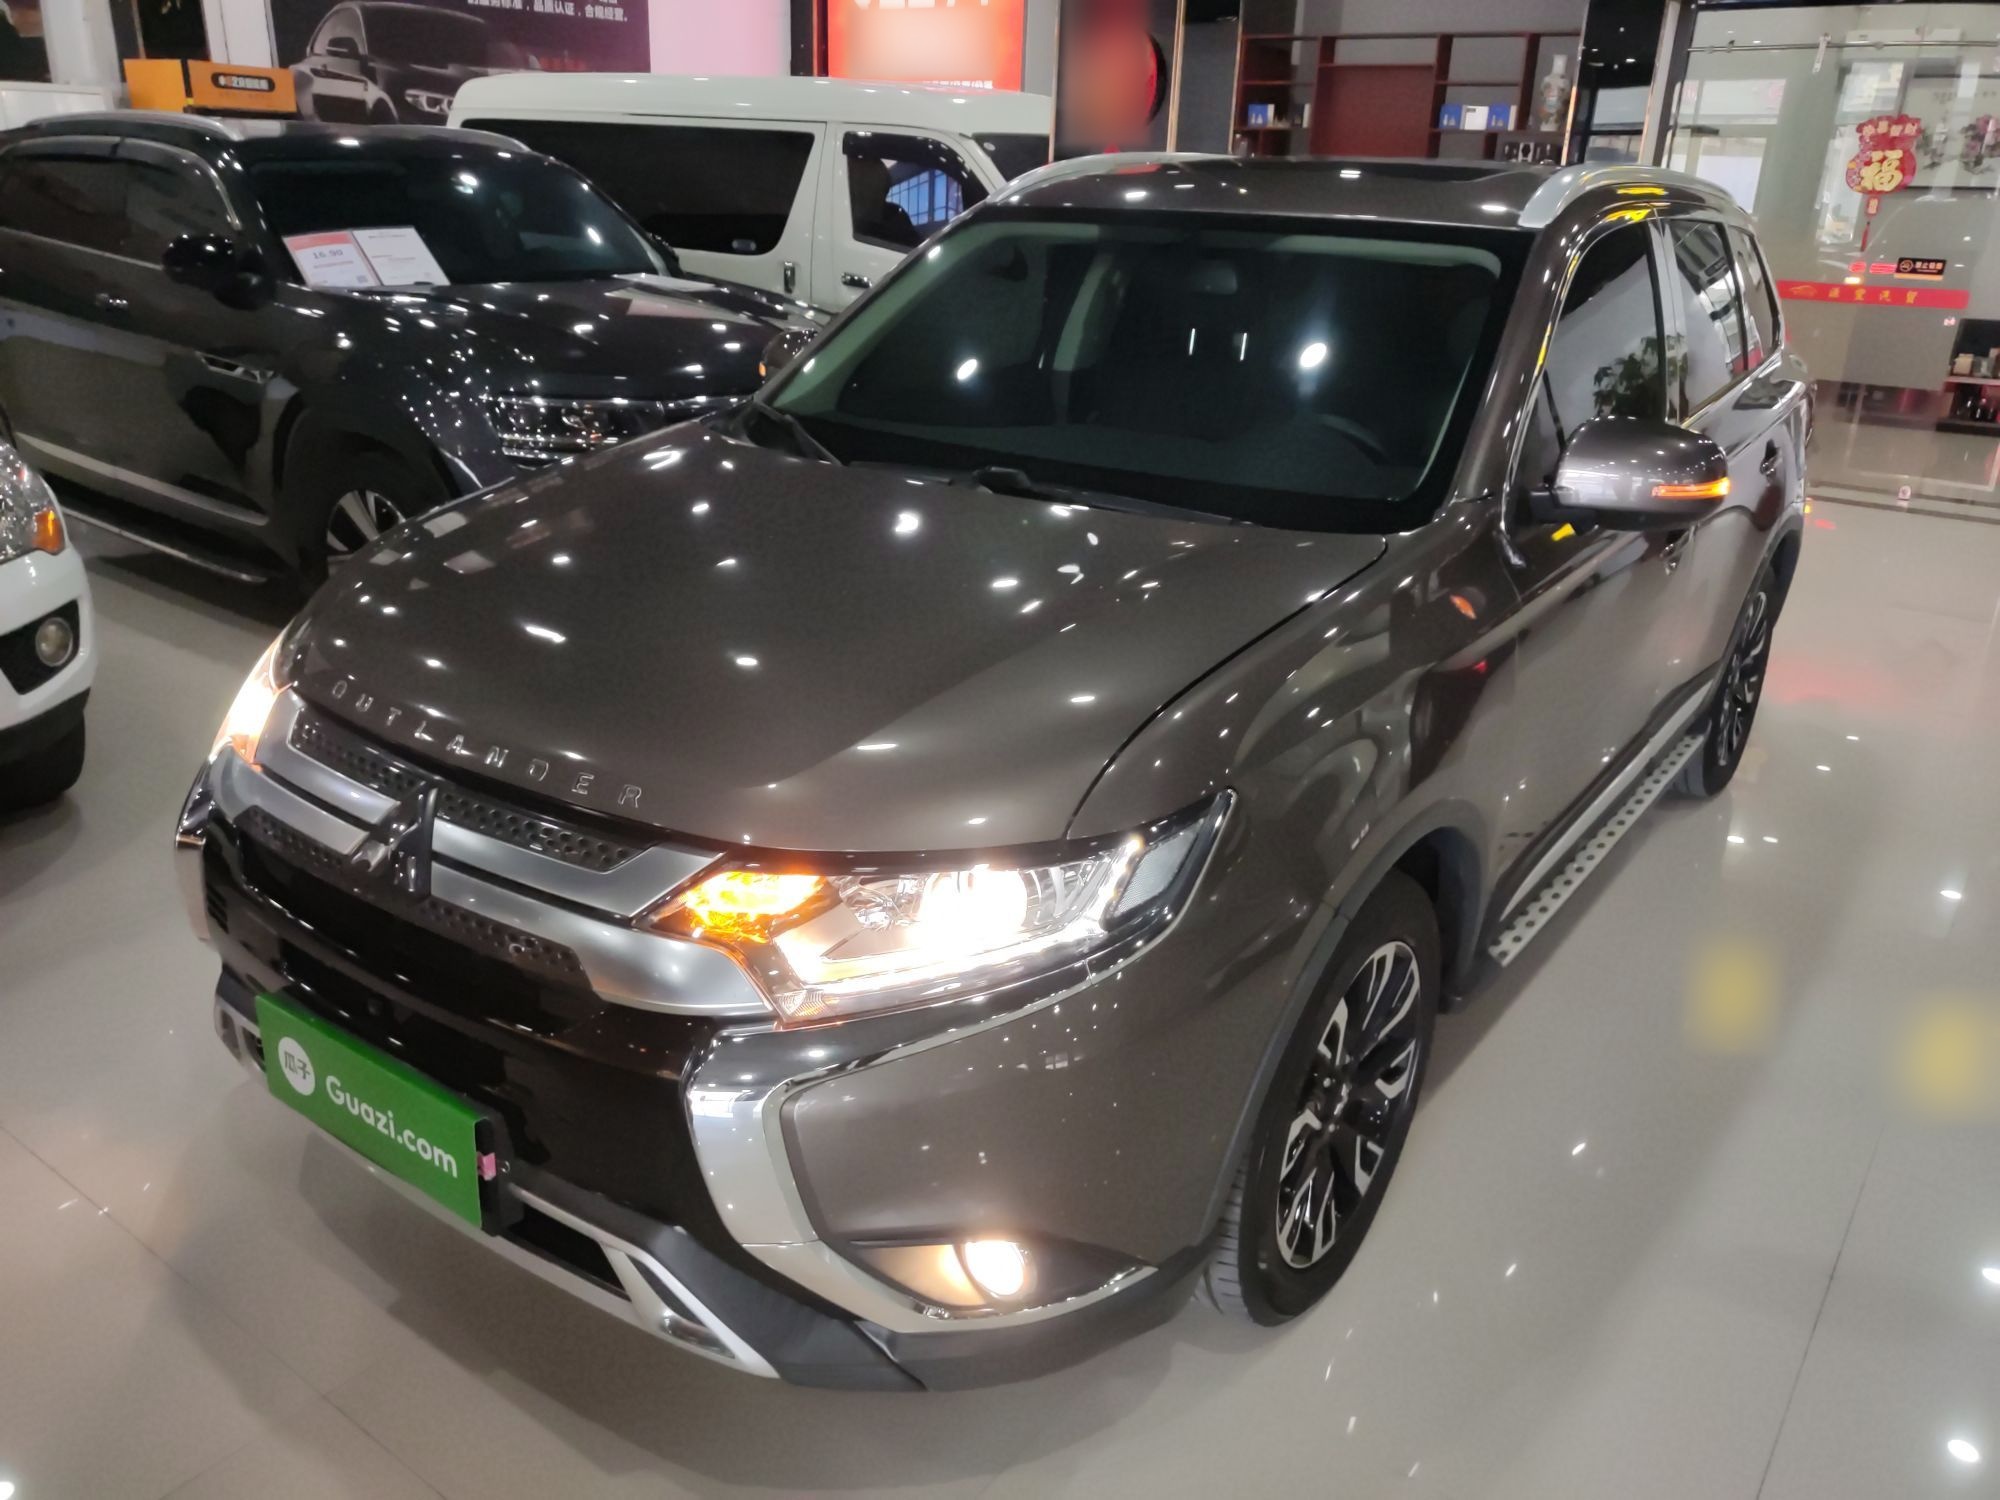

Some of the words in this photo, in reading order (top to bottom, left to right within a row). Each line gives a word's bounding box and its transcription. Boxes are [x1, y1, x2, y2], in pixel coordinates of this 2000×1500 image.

[1860, 149, 1903, 192] 福
[331, 679, 642, 809] OUTLANDER
[284, 1050, 311, 1081] 瓜子
[325, 1074, 458, 1179] Guazi.com
